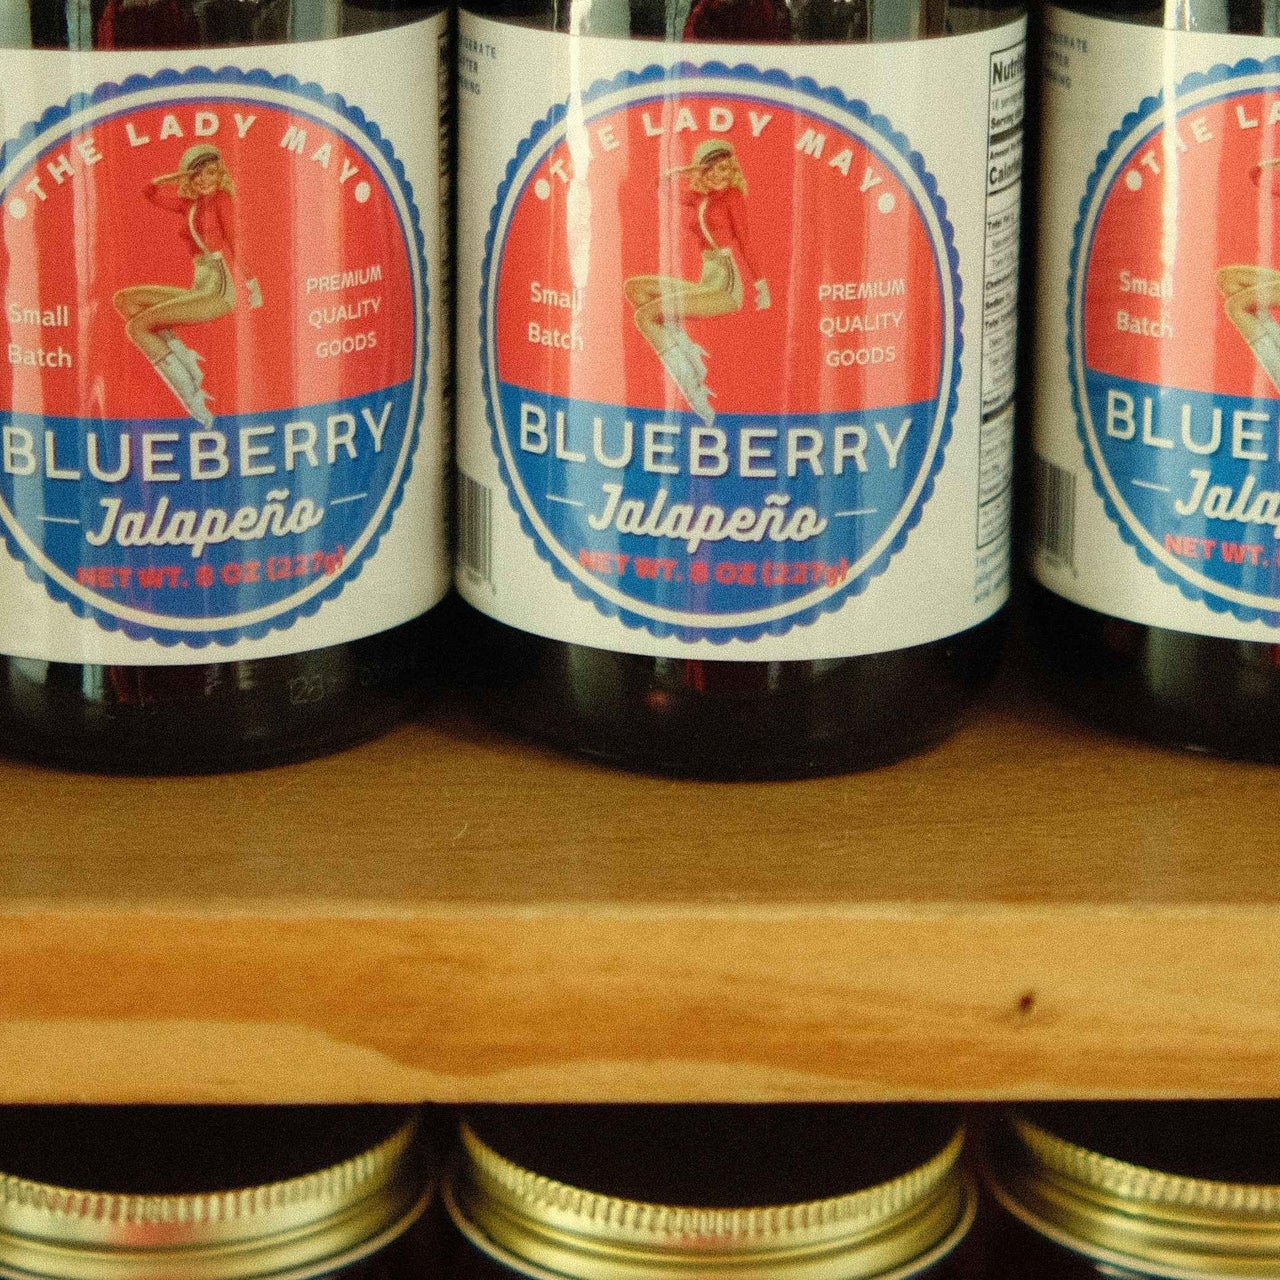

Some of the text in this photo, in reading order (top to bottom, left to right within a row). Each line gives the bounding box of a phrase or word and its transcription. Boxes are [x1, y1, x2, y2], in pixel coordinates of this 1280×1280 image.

[24, 113, 360, 202] THE LADY MAY
[548, 105, 884, 194] TE LADY MAY
[304, 264, 383, 296] PREMIUM
[818, 276, 907, 303] PREMIUM
[307, 296, 383, 327] QUALITY
[529, 281, 583, 312] Small
[7, 302, 70, 330] Small
[819, 309, 906, 337] QUALITY
[1116, 310, 1175, 340] Batch
[314, 330, 378, 359] GOODS
[527, 322, 585, 352] Batch
[6, 342, 74, 370] Batch
[825, 343, 897, 368] GOODS
[1, 400, 393, 484] BLUEBERRY
[519, 401, 914, 478] BLUEBERRY
[84, 488, 326, 559] Jalapeño
[588, 482, 830, 554] Jalapeño
[1163, 533, 1217, 562] NET
[1219, 540, 1271, 568] WT.
[75, 543, 347, 590] NET WT. 8 OZ (227g)
[577, 548, 851, 589] NET WT. 8 OZ (227g)
